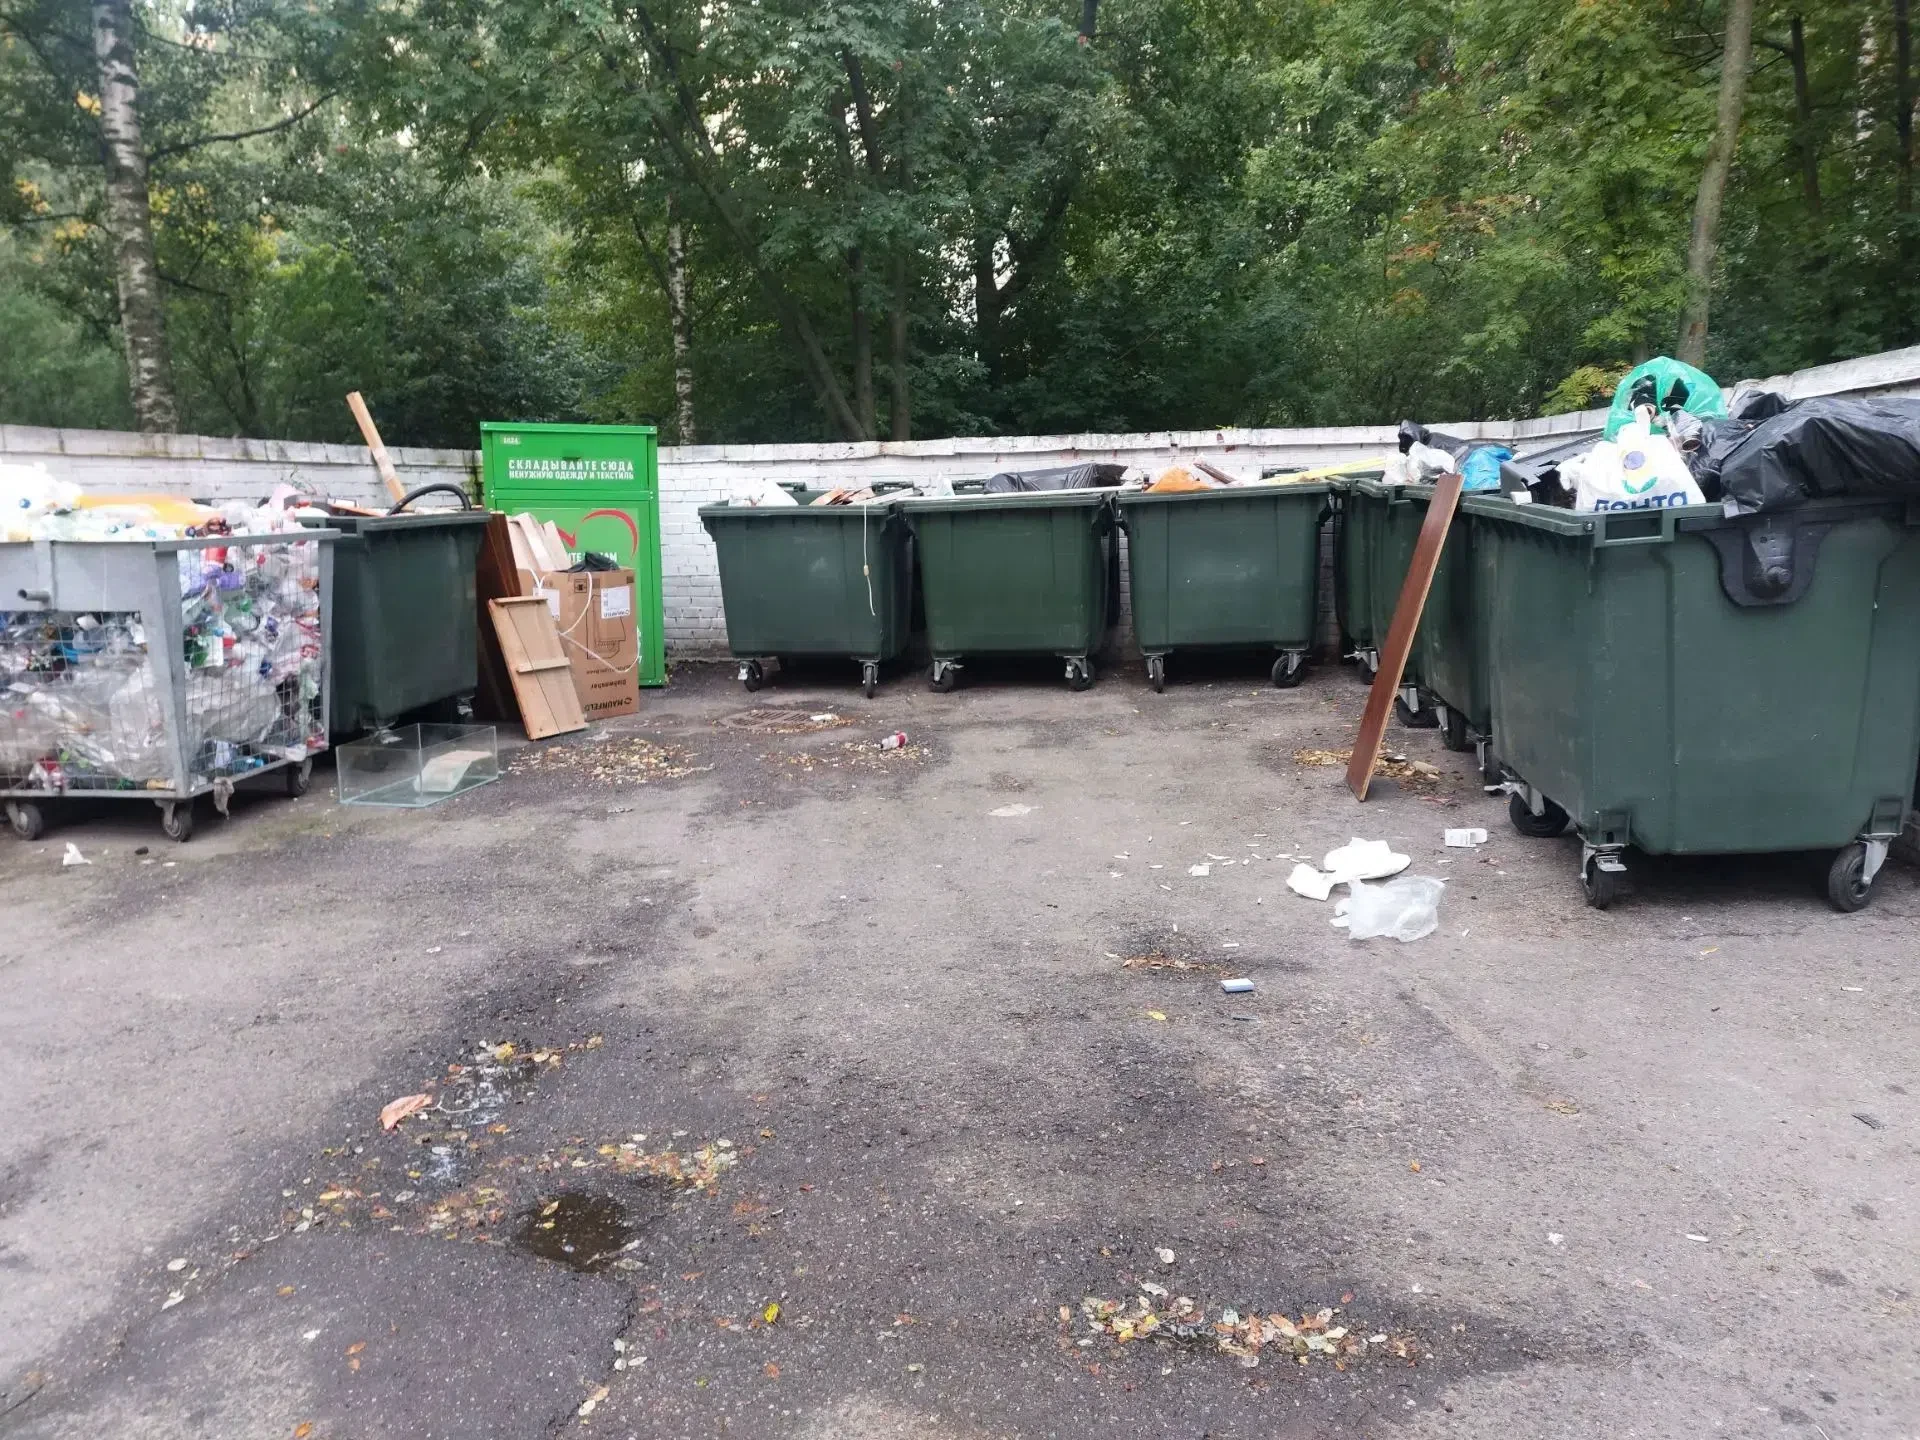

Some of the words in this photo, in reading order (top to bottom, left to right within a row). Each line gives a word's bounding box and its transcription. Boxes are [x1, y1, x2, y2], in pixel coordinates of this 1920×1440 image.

[508, 459, 597, 471] СКЛАДЫВАЙТЕ
[600, 461, 633, 472] СЮДА
[509, 470, 553, 480] НЕНУЖНУЮ
[555, 471, 587, 480] ОДЕЖДУ
[589, 471, 595, 480] И
[597, 471, 634, 480] ТЕКСТИЛЬ
[591, 679, 627, 689] Dishwasher
[584, 699, 623, 712] MAUNFELD
